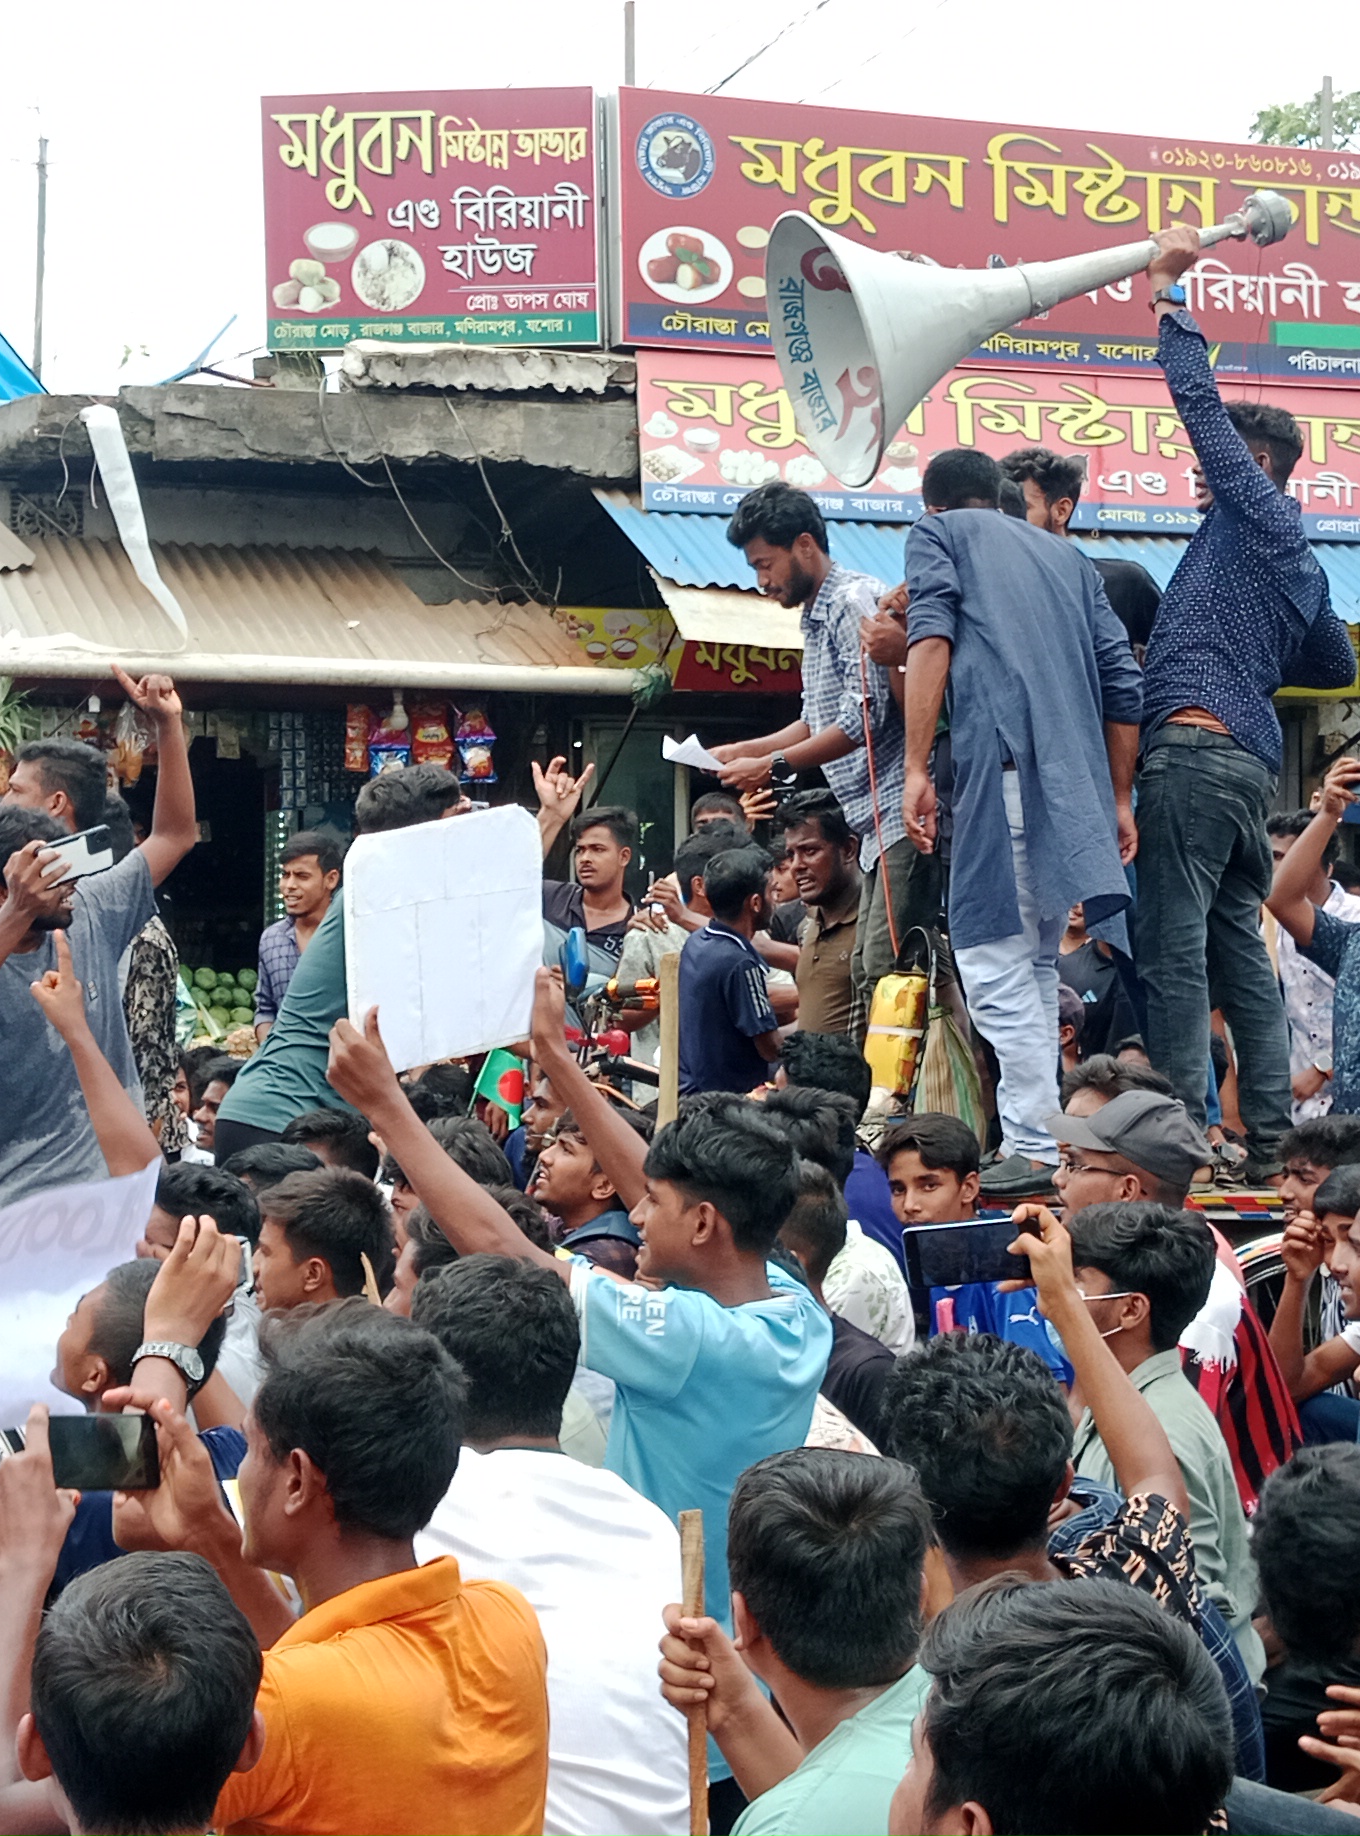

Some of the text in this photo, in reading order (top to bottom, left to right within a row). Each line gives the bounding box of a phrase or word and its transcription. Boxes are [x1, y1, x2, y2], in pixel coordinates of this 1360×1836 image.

[271, 105, 436, 215] মধুবন
[450, 182, 589, 231] বিরিয়ানী
[728, 134, 969, 234] মধুবন
[438, 233, 537, 280] হাউজ
[503, 293, 549, 310] তাপস
[662, 309, 738, 337] চৌরাস্তা
[1152, 511, 1206, 527] ০১৯২
